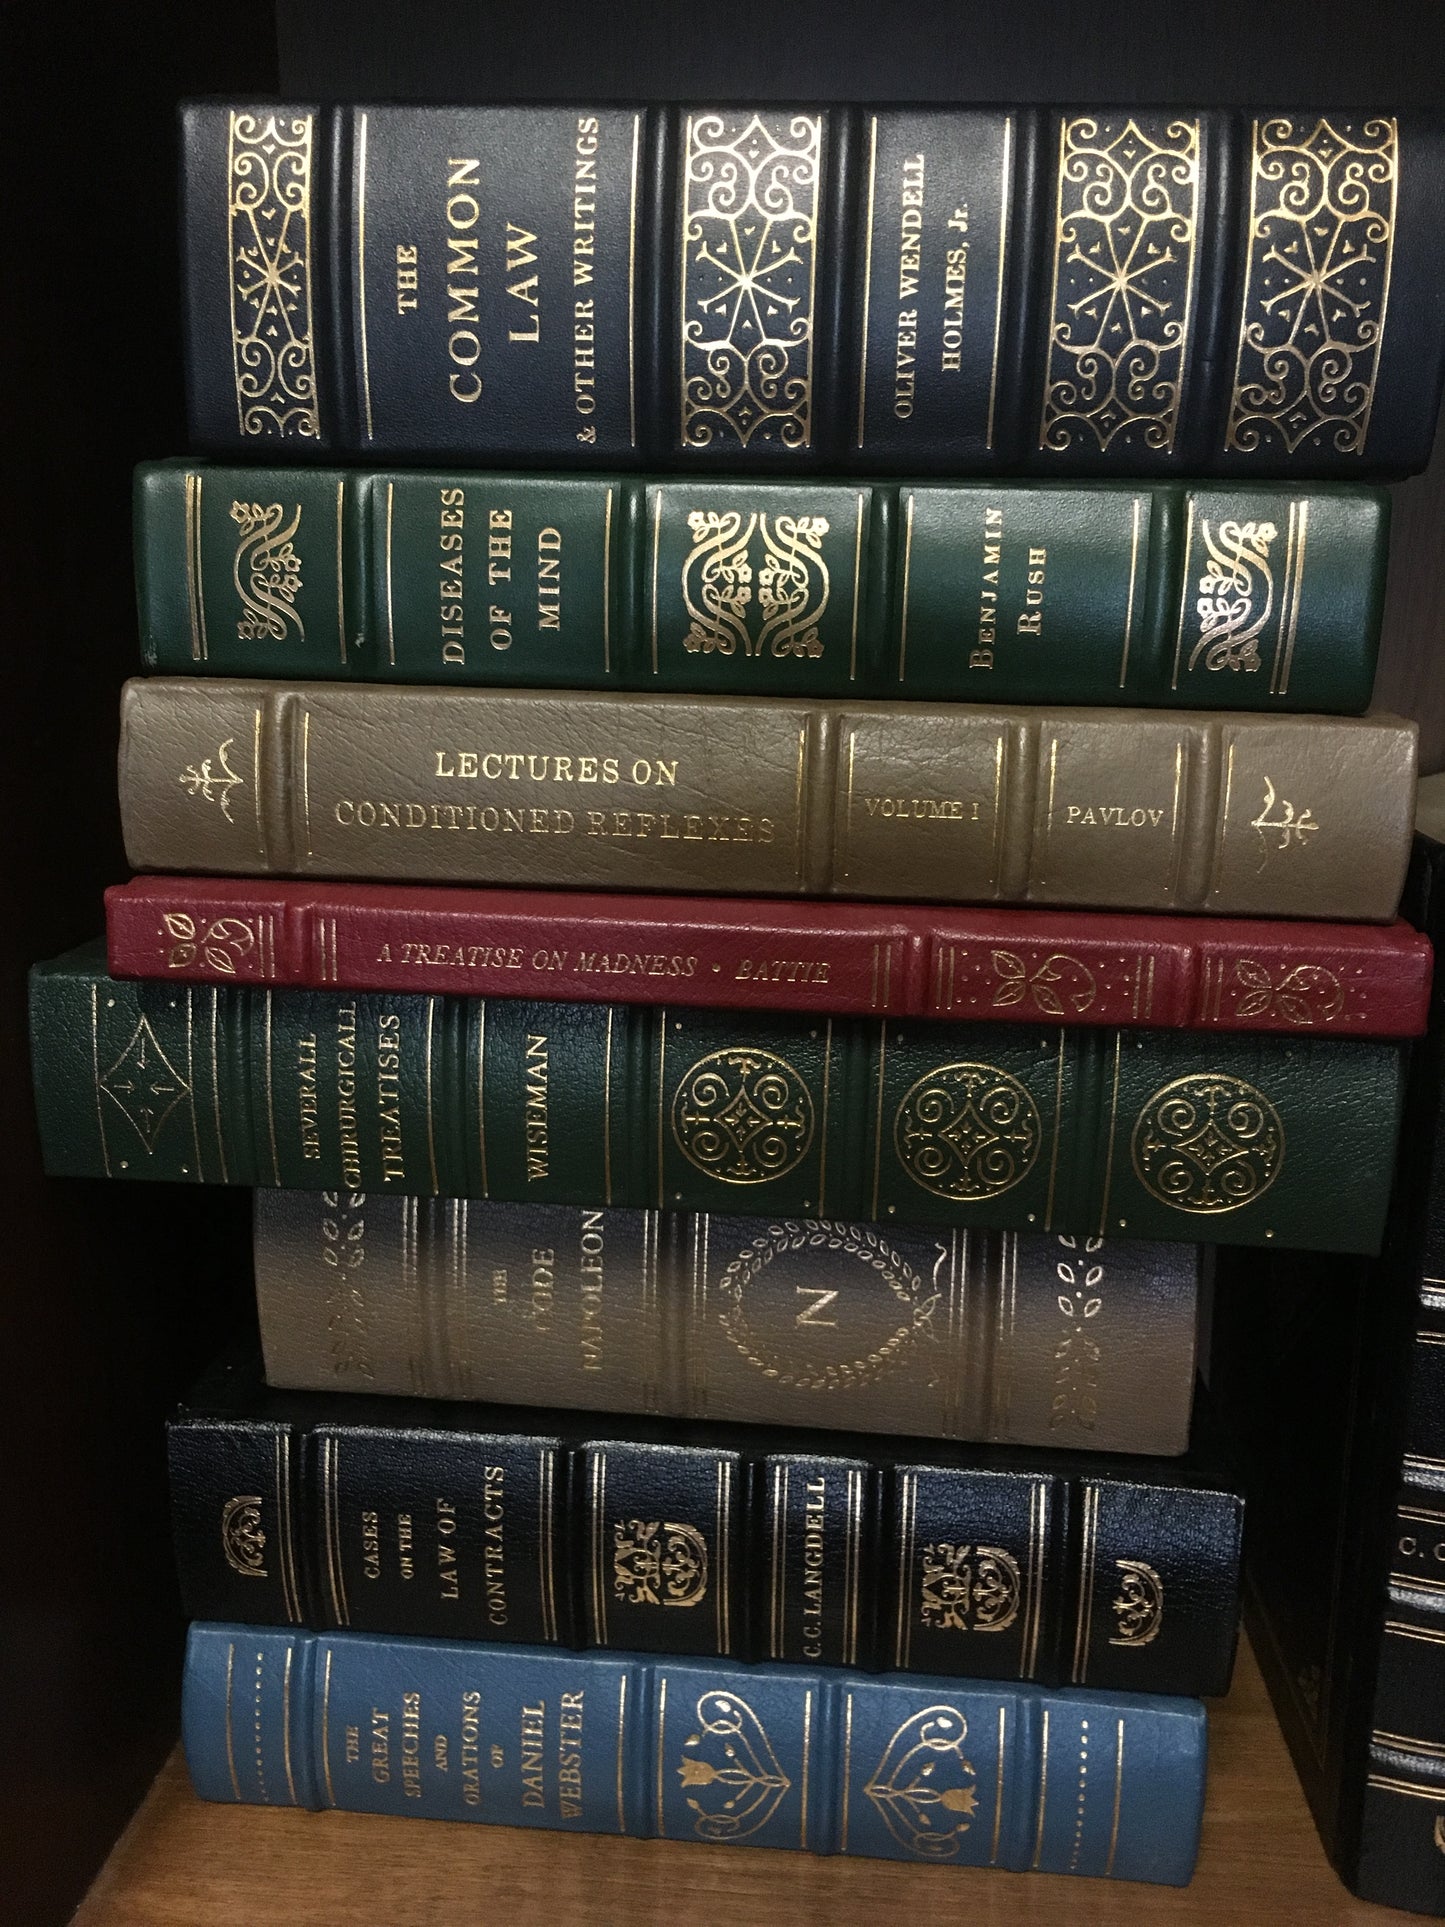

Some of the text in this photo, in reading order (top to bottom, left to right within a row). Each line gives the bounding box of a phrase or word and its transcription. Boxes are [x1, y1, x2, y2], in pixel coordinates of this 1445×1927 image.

[396, 245, 419, 315] THE
[447, 157, 483, 403] COMMON
[505, 221, 540, 344] LAW
[573, 116, 600, 444] & OTHER WRITINGS
[894, 154, 925, 419] OLIVER WENDELL
[942, 203, 970, 373] HOLMES, Jr.
[440, 487, 465, 666] DISEASES
[488, 509, 513, 651] OF THE
[537, 526, 562, 632] MIND
[968, 507, 1003, 670] BENJAMIN
[1017, 547, 1047, 636] RUSH
[334, 799, 777, 845] CONDITIONED REFLEXES
[435, 751, 680, 786] LECTURES ON
[864, 798, 980, 821] VOLUME I
[1066, 805, 1165, 827] PAVLOV
[376, 943, 832, 984] A TREATISE ON MADNESS BATTIE
[299, 1031, 321, 1159] SEVERALL
[337, 1001, 363, 1189] CHIRURGICALL
[377, 1013, 406, 1182] TREATISES
[525, 1034, 549, 1182] WISEMAN
[361, 1511, 381, 1580] CASES
[397, 1513, 415, 1580] ON THE
[436, 1498, 460, 1600] LAW OF
[484, 1465, 509, 1626] CONTRACTS
[803, 1476, 825, 1617] LANGDELL
[345, 1724, 360, 1763] THE
[371, 1707, 391, 1784] GREAT
[401, 1690, 423, 1799] SPEECHES
[433, 1734, 449, 1773] AND
[461, 1690, 482, 1806] ORATIONS
[489, 1744, 505, 1769] OF
[521, 1700, 546, 1809] DANIEL
[558, 1689, 586, 1820] WEBSTER
